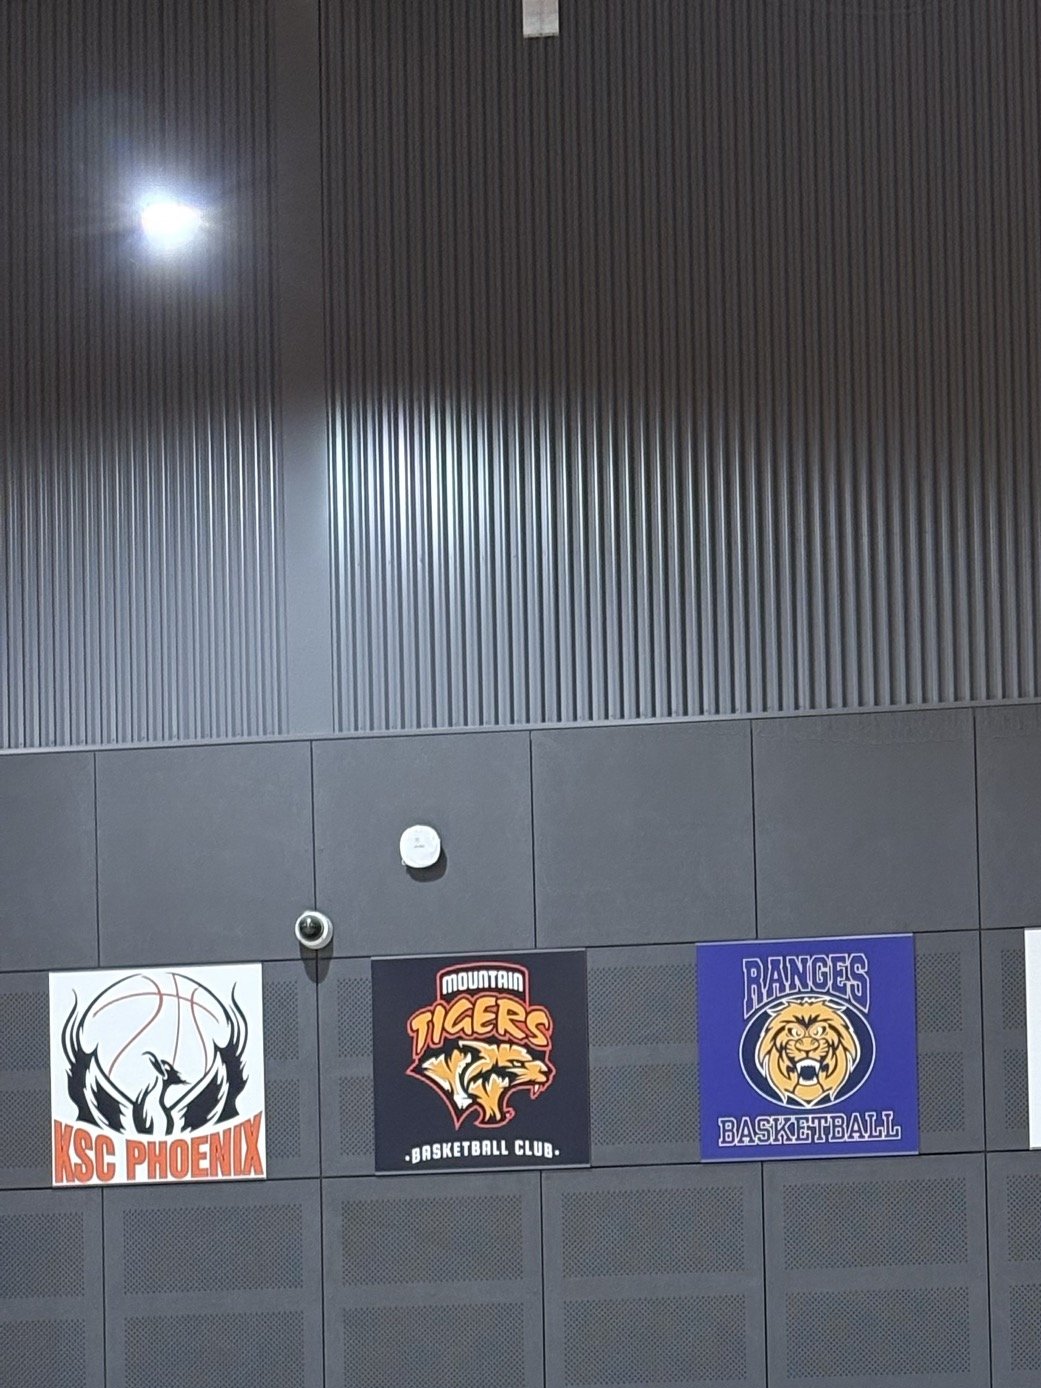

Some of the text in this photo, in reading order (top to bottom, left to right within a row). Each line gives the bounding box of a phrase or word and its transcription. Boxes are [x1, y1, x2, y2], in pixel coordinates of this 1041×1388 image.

[442, 970, 524, 995] MOUNTAIN
[742, 952, 870, 1019] RANGES
[410, 996, 551, 1055] TIGERS
[54, 1110, 264, 1184] KSC PHOENIX
[411, 1139, 553, 1165] BASKETBALL CLUB
[718, 1111, 901, 1147] BASKETBALL
